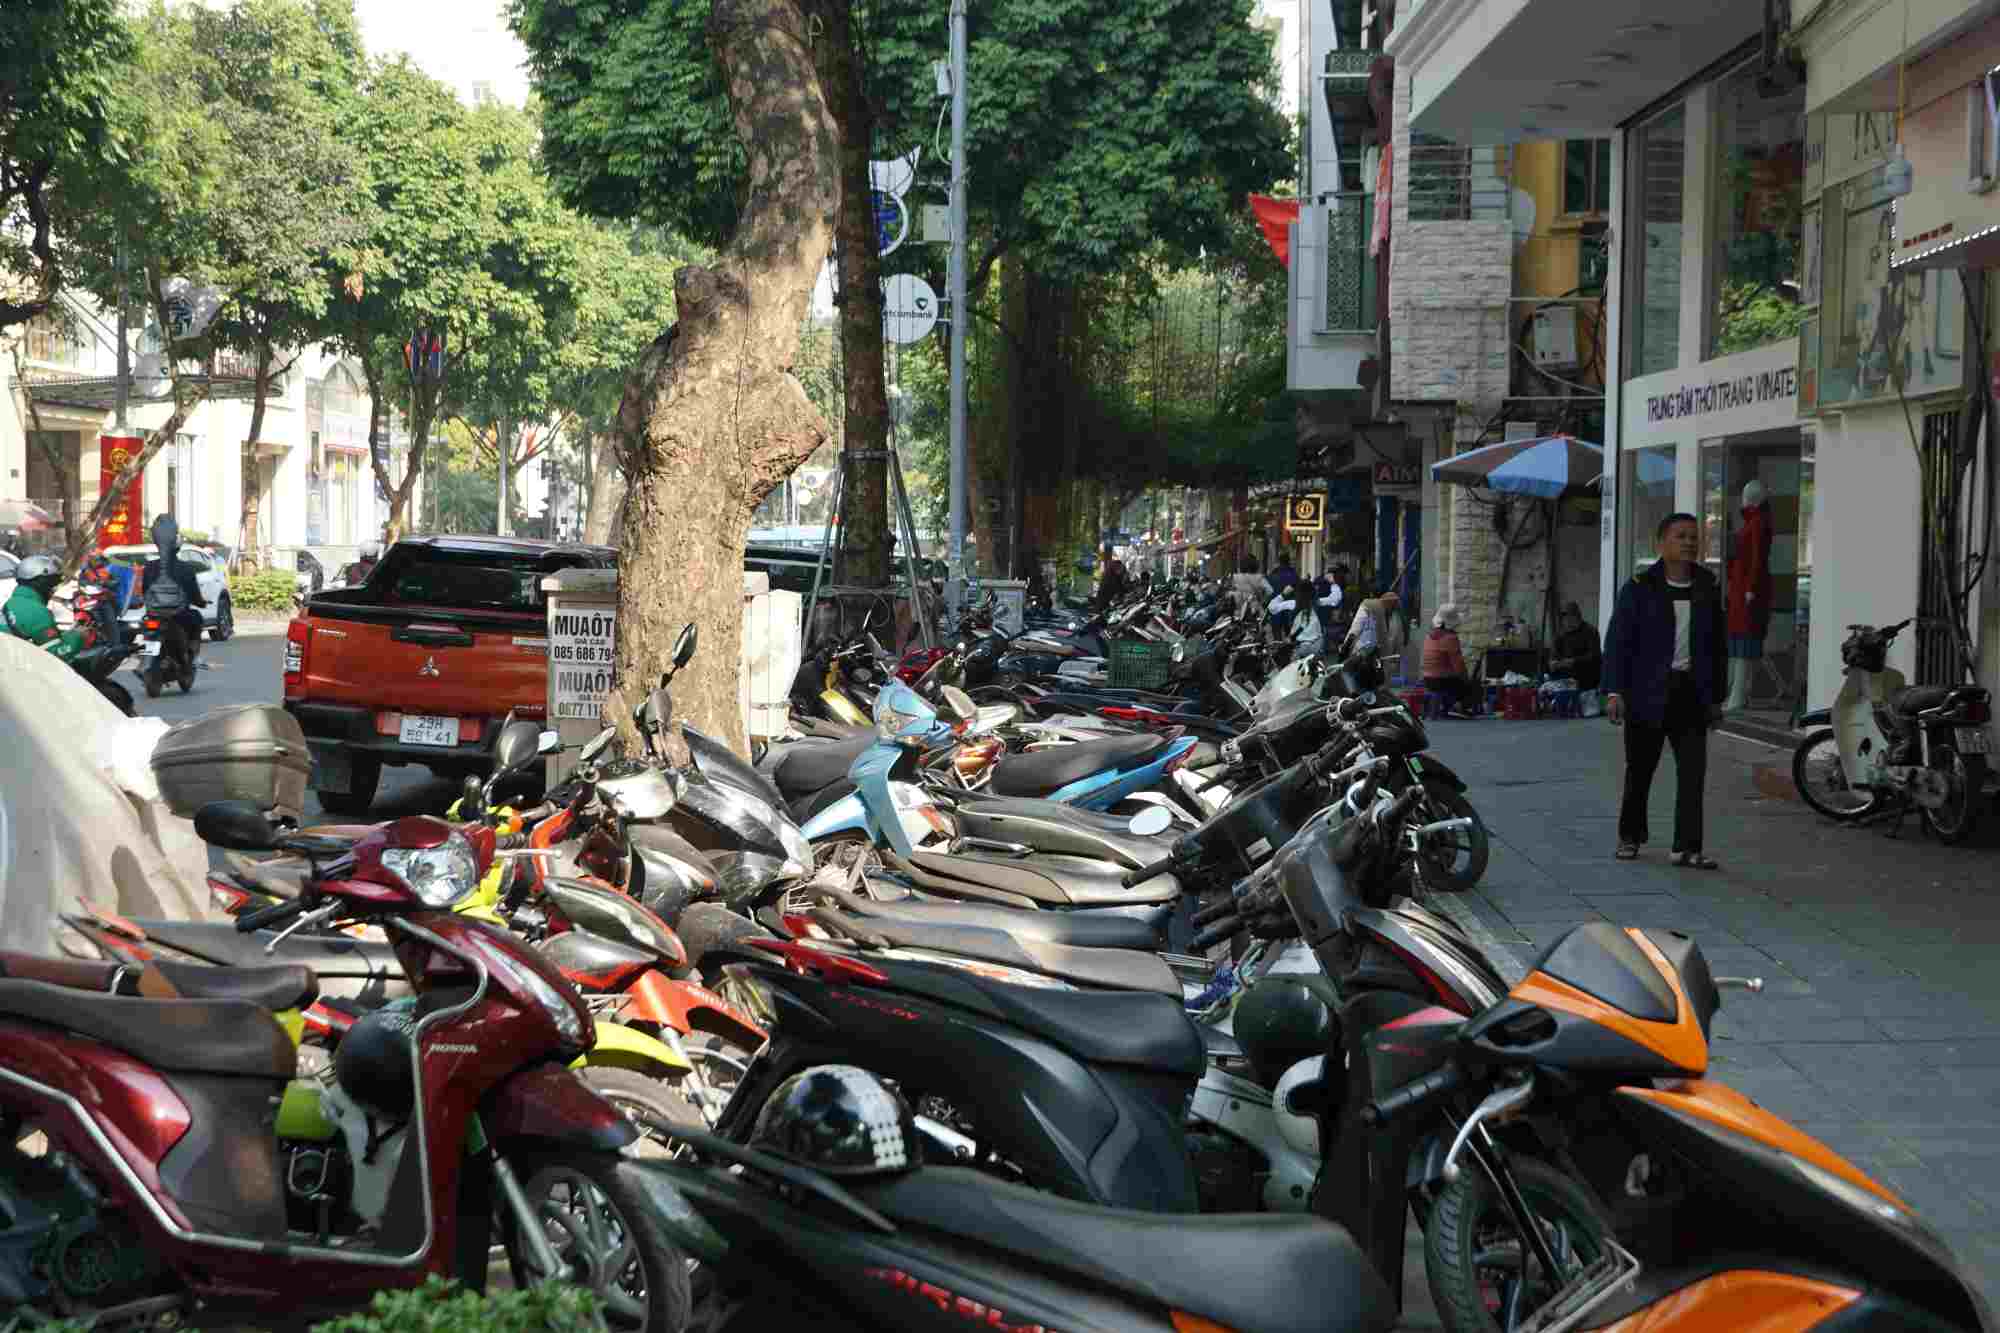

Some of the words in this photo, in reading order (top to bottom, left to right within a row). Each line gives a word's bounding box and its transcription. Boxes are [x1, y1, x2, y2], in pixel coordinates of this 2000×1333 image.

[1648, 394, 1674, 422] TRUNG
[1675, 385, 1693, 419] TÂM
[1717, 376, 1752, 411] TRANG
[554, 645, 573, 659] 085
[431, 1044, 478, 1054] HONDA
